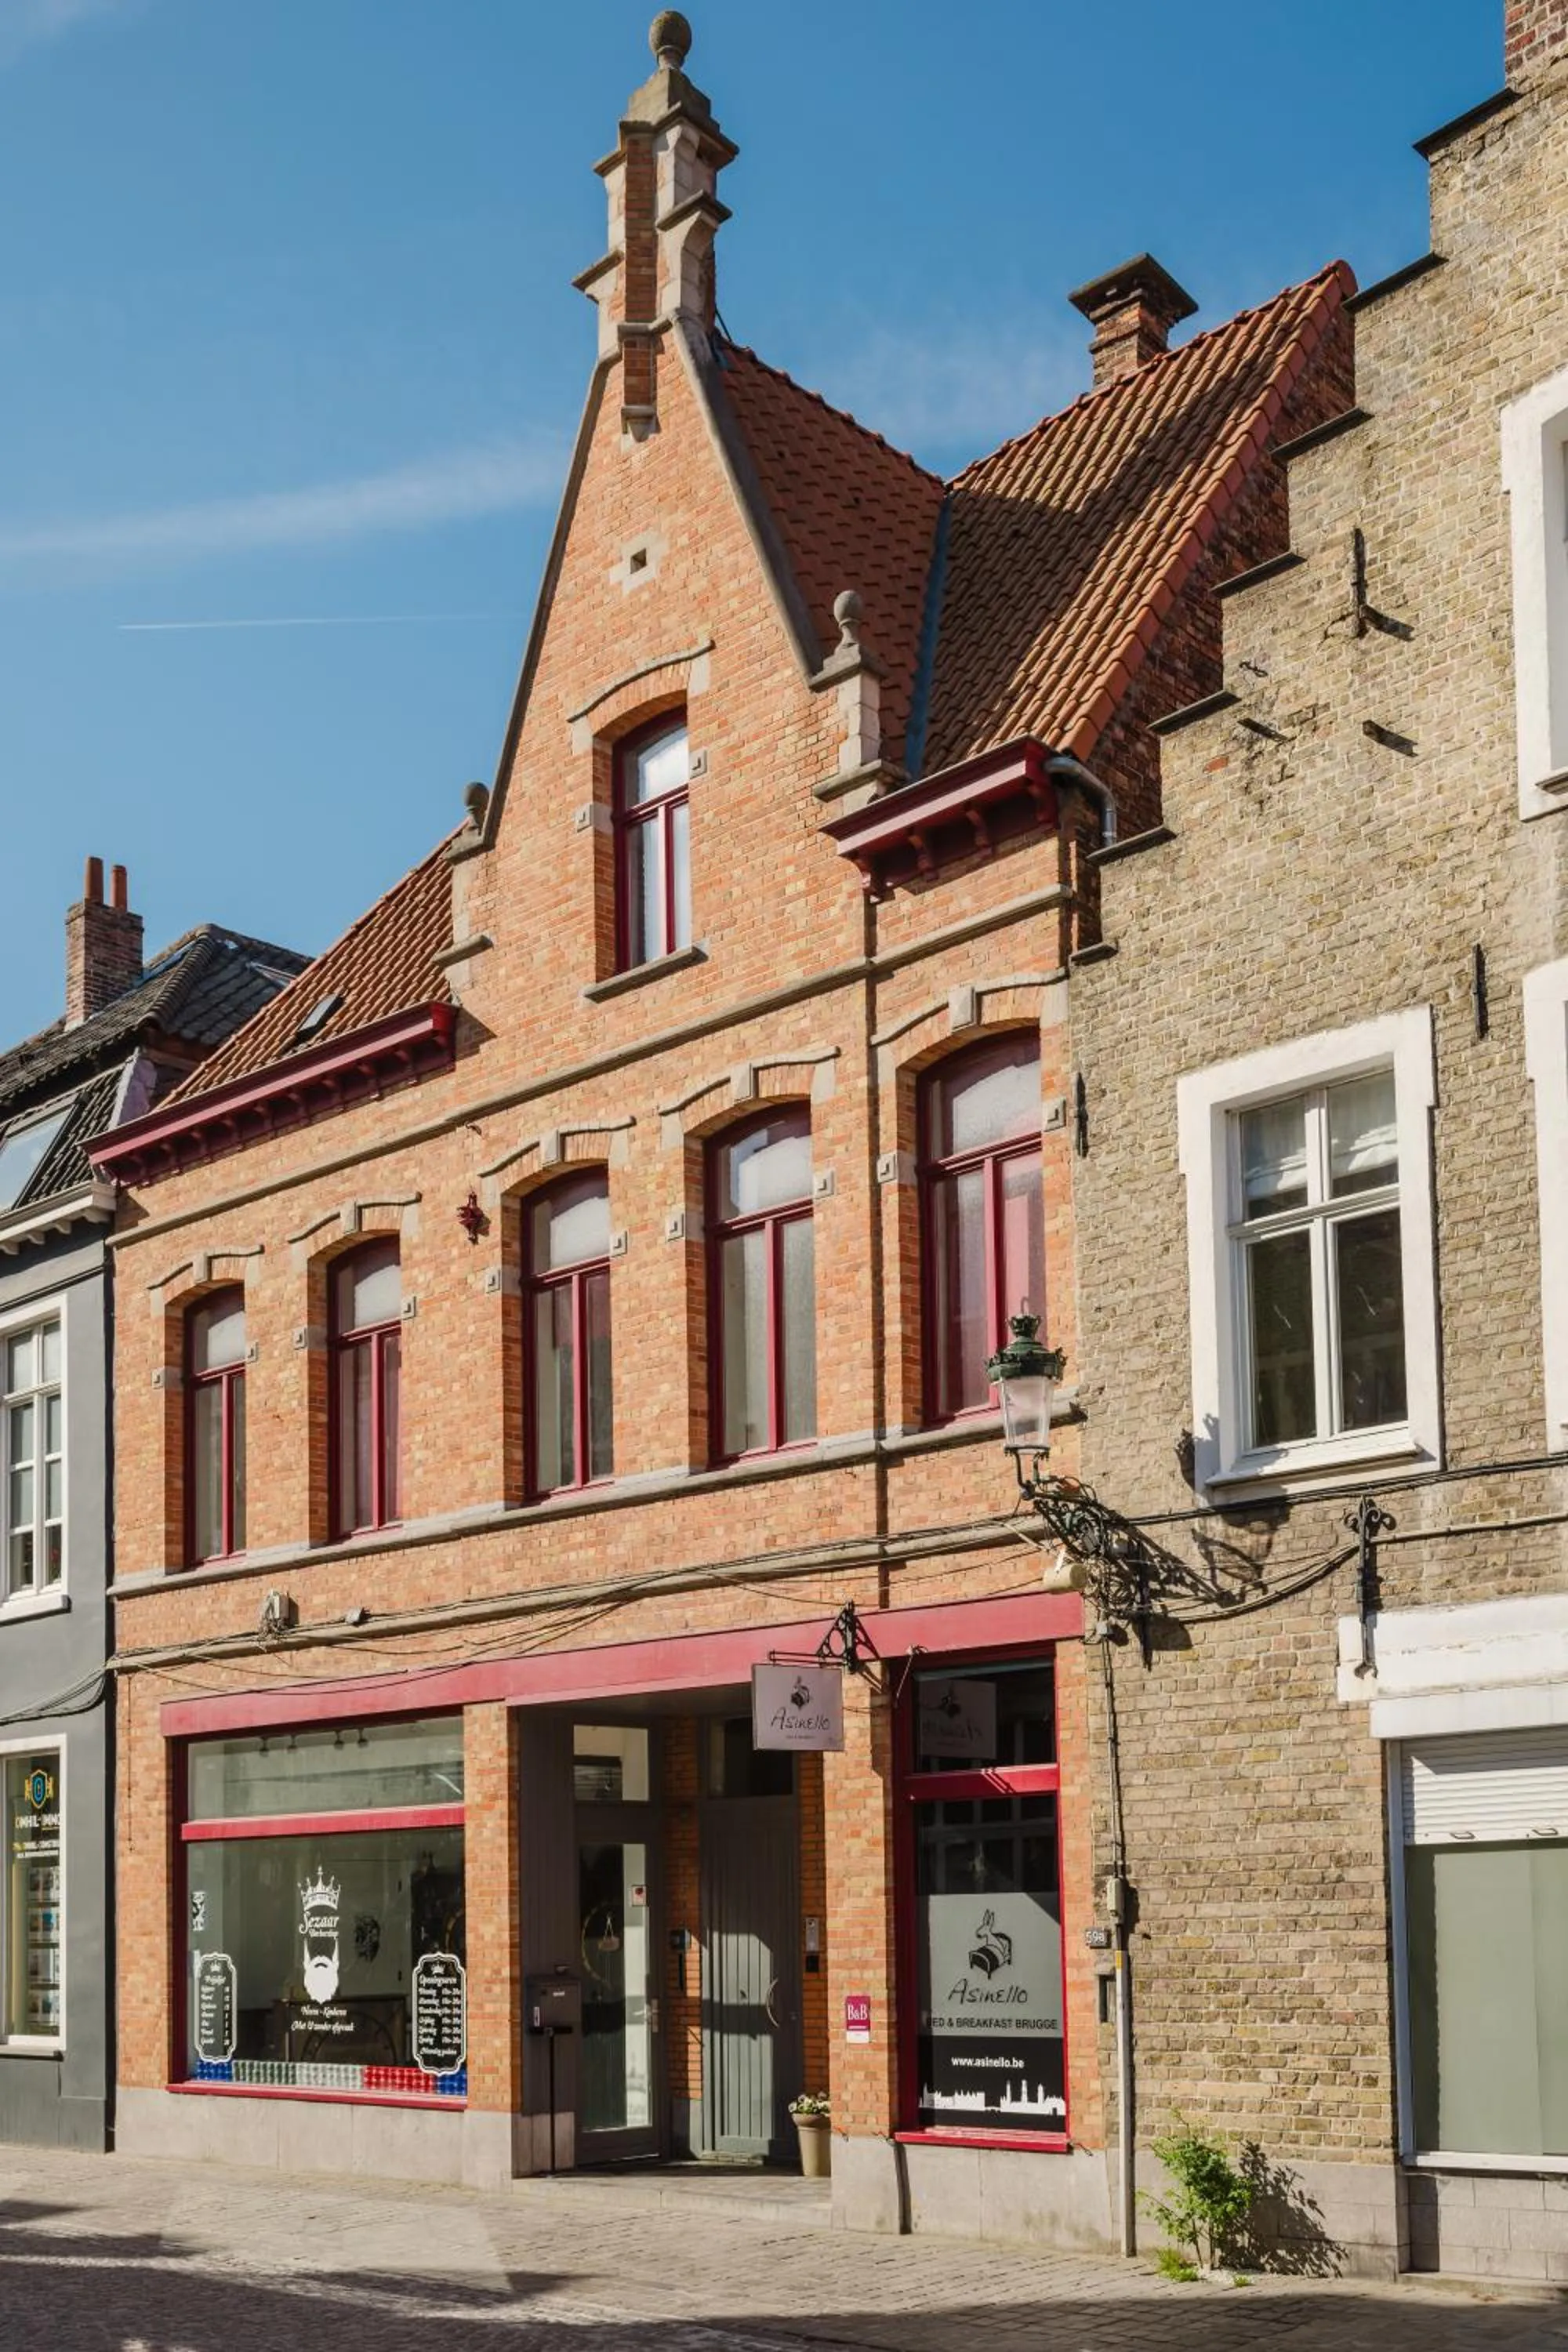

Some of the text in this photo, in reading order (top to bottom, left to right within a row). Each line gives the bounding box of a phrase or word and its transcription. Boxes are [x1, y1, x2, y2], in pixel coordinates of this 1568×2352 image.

[948, 1978, 1029, 2005] Asinello
[848, 2004, 868, 2020] B&B
[927, 2017, 1058, 2030] BED & BREAKFAST BRUGGE
[951, 2056, 1025, 2069] www.asinello.be
